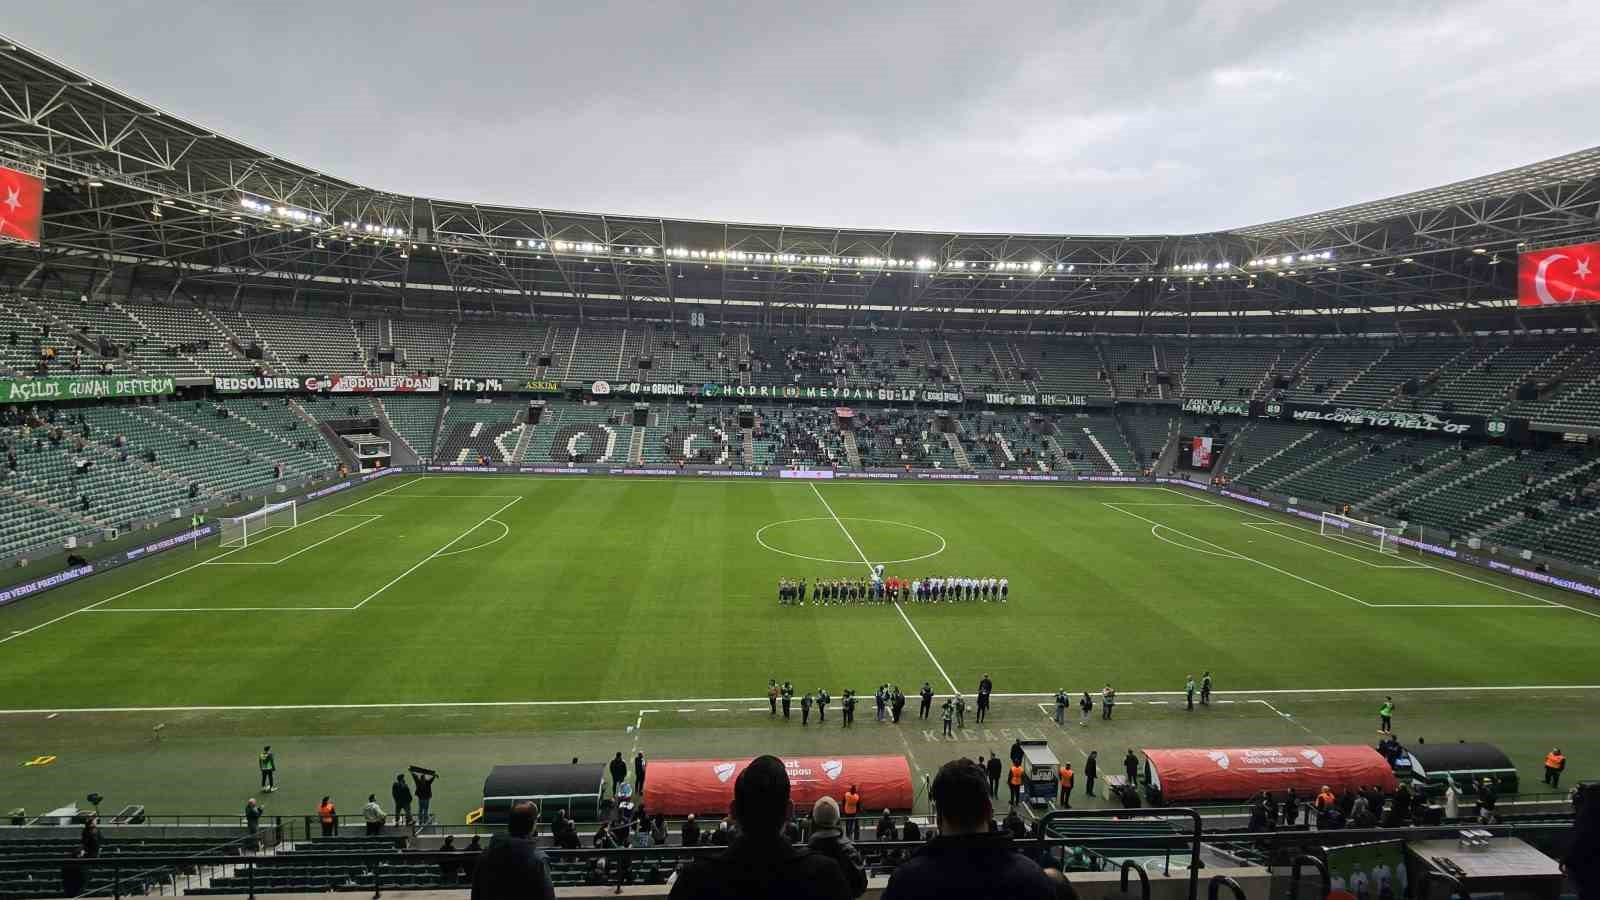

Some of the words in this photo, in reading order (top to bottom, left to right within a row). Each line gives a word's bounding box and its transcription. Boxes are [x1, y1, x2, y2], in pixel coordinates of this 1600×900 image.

[215, 376, 299, 390] REDSOLDIERS
[1293, 409, 1364, 424] WELCOME
[1370, 414, 1389, 426] TO
[1394, 418, 1438, 431] HELL
[1444, 422, 1471, 434] OF
